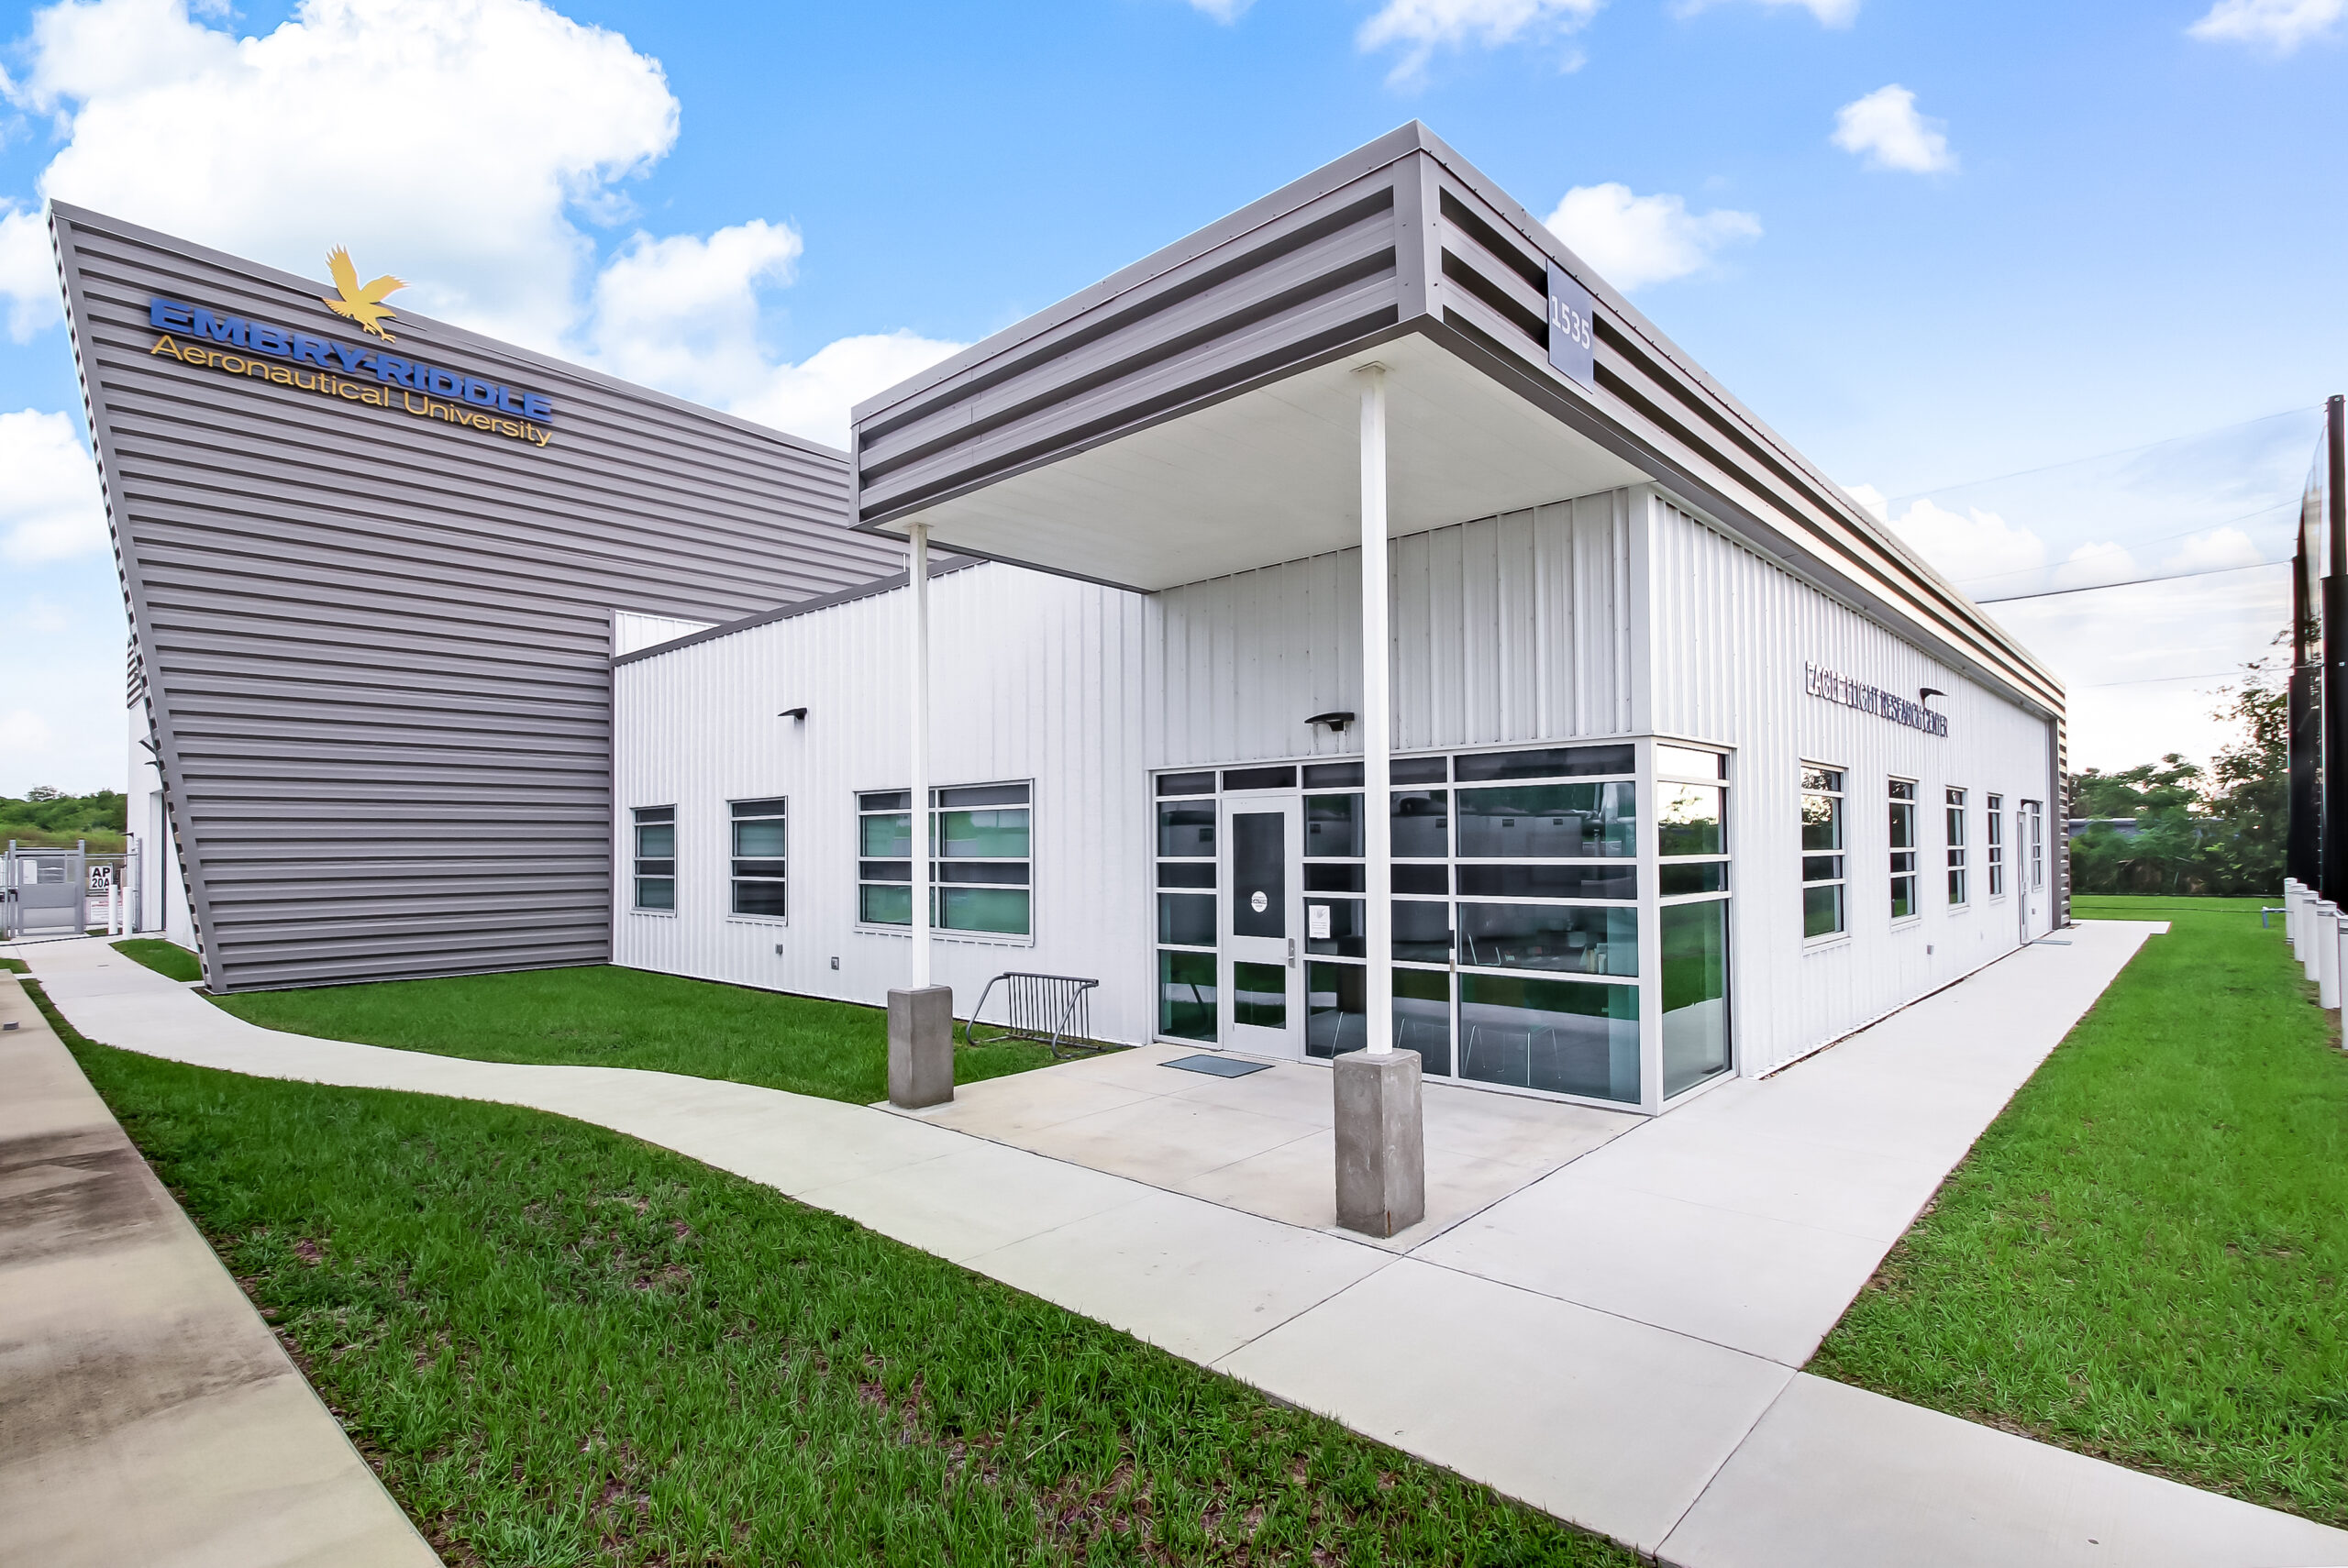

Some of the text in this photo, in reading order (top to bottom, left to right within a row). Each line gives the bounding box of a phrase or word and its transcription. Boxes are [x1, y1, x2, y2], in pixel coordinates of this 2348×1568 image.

[1552, 295, 1590, 349] 1535
[150, 296, 553, 423] EMBRY-RIDDLE
[150, 335, 552, 447] Aeronautical University
[1805, 660, 1948, 738] EAGLE FLIGHT RESEARCH CENTER
[92, 867, 110, 878] AP
[92, 878, 110, 888] 20A
